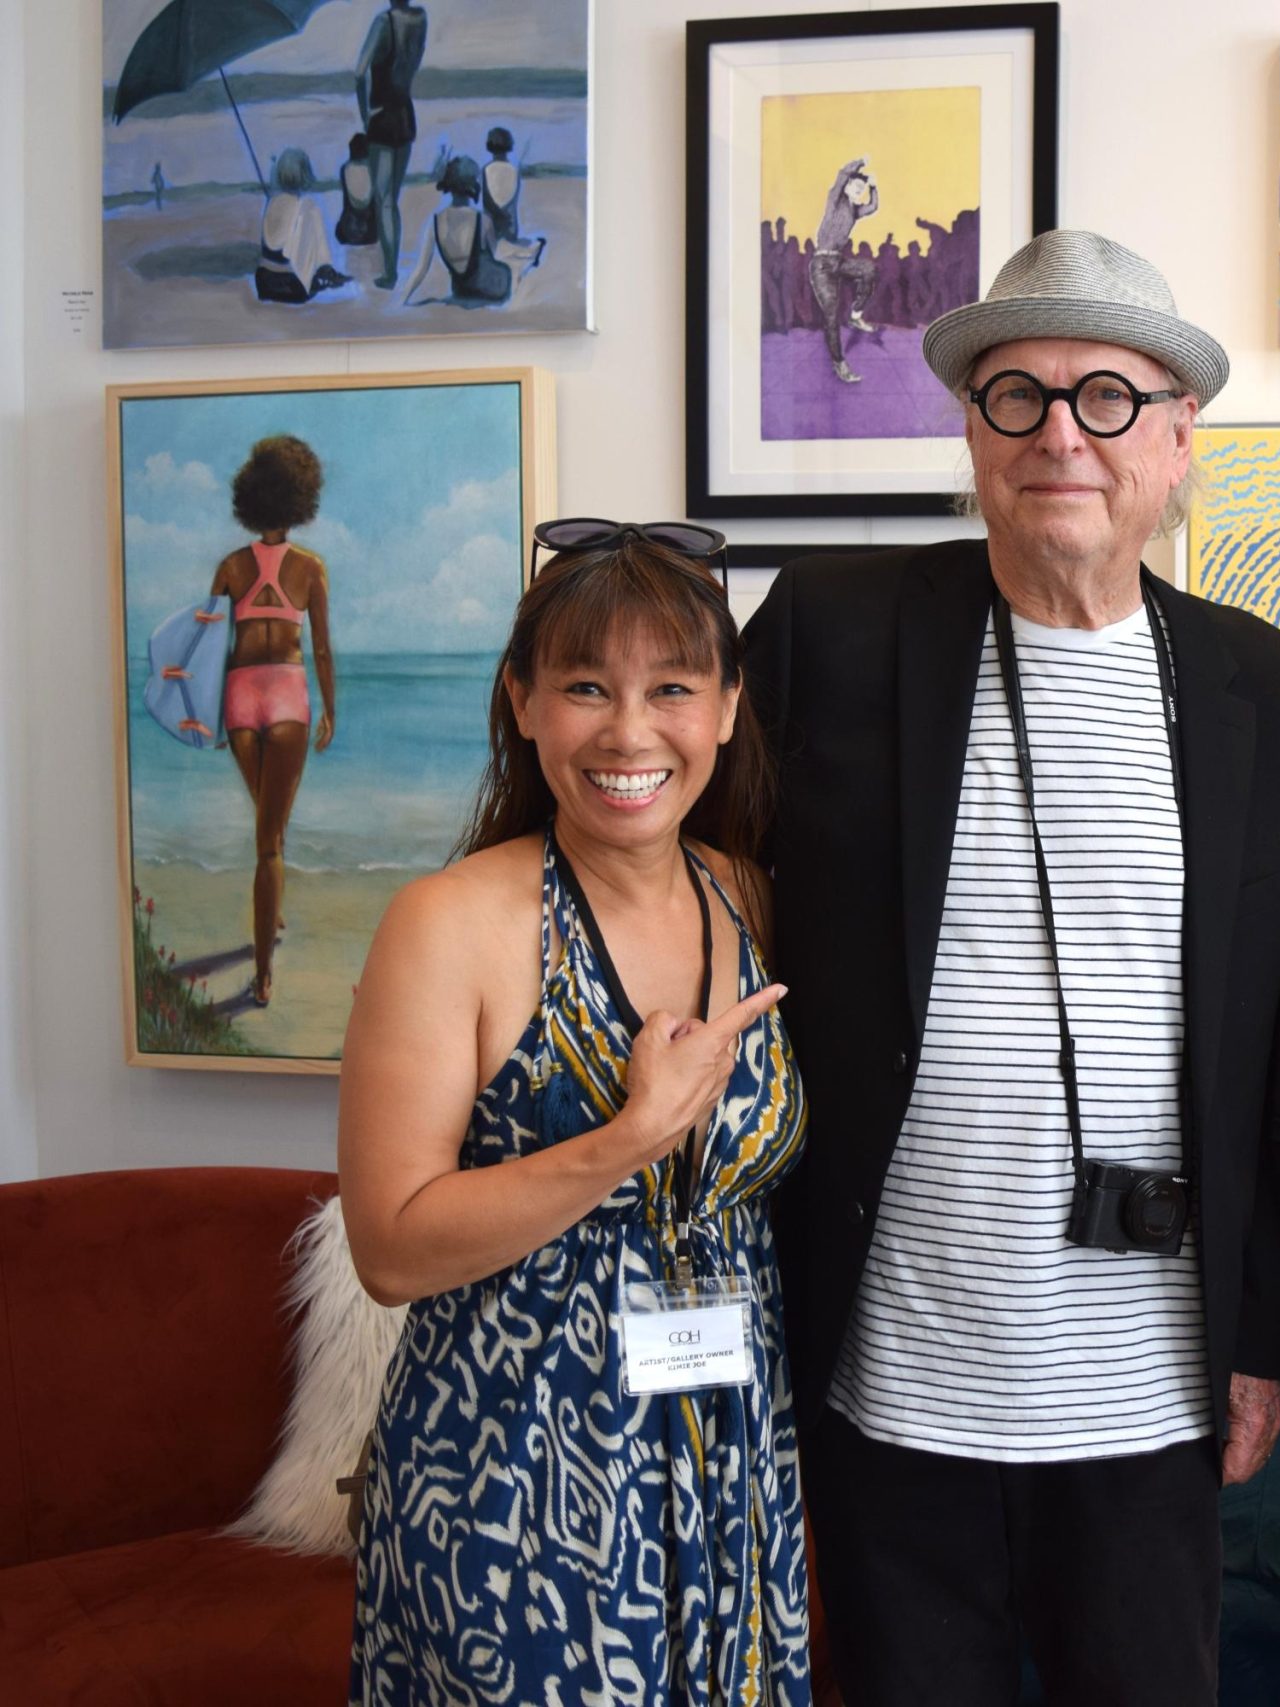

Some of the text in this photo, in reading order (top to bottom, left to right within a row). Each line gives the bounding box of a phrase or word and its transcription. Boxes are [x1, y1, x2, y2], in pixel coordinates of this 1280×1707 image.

[1168, 695, 1177, 723] SONY
[639, 1349, 734, 1367] ARTIST/GALLERY OWNER
[693, 1361, 706, 1369] JOE
